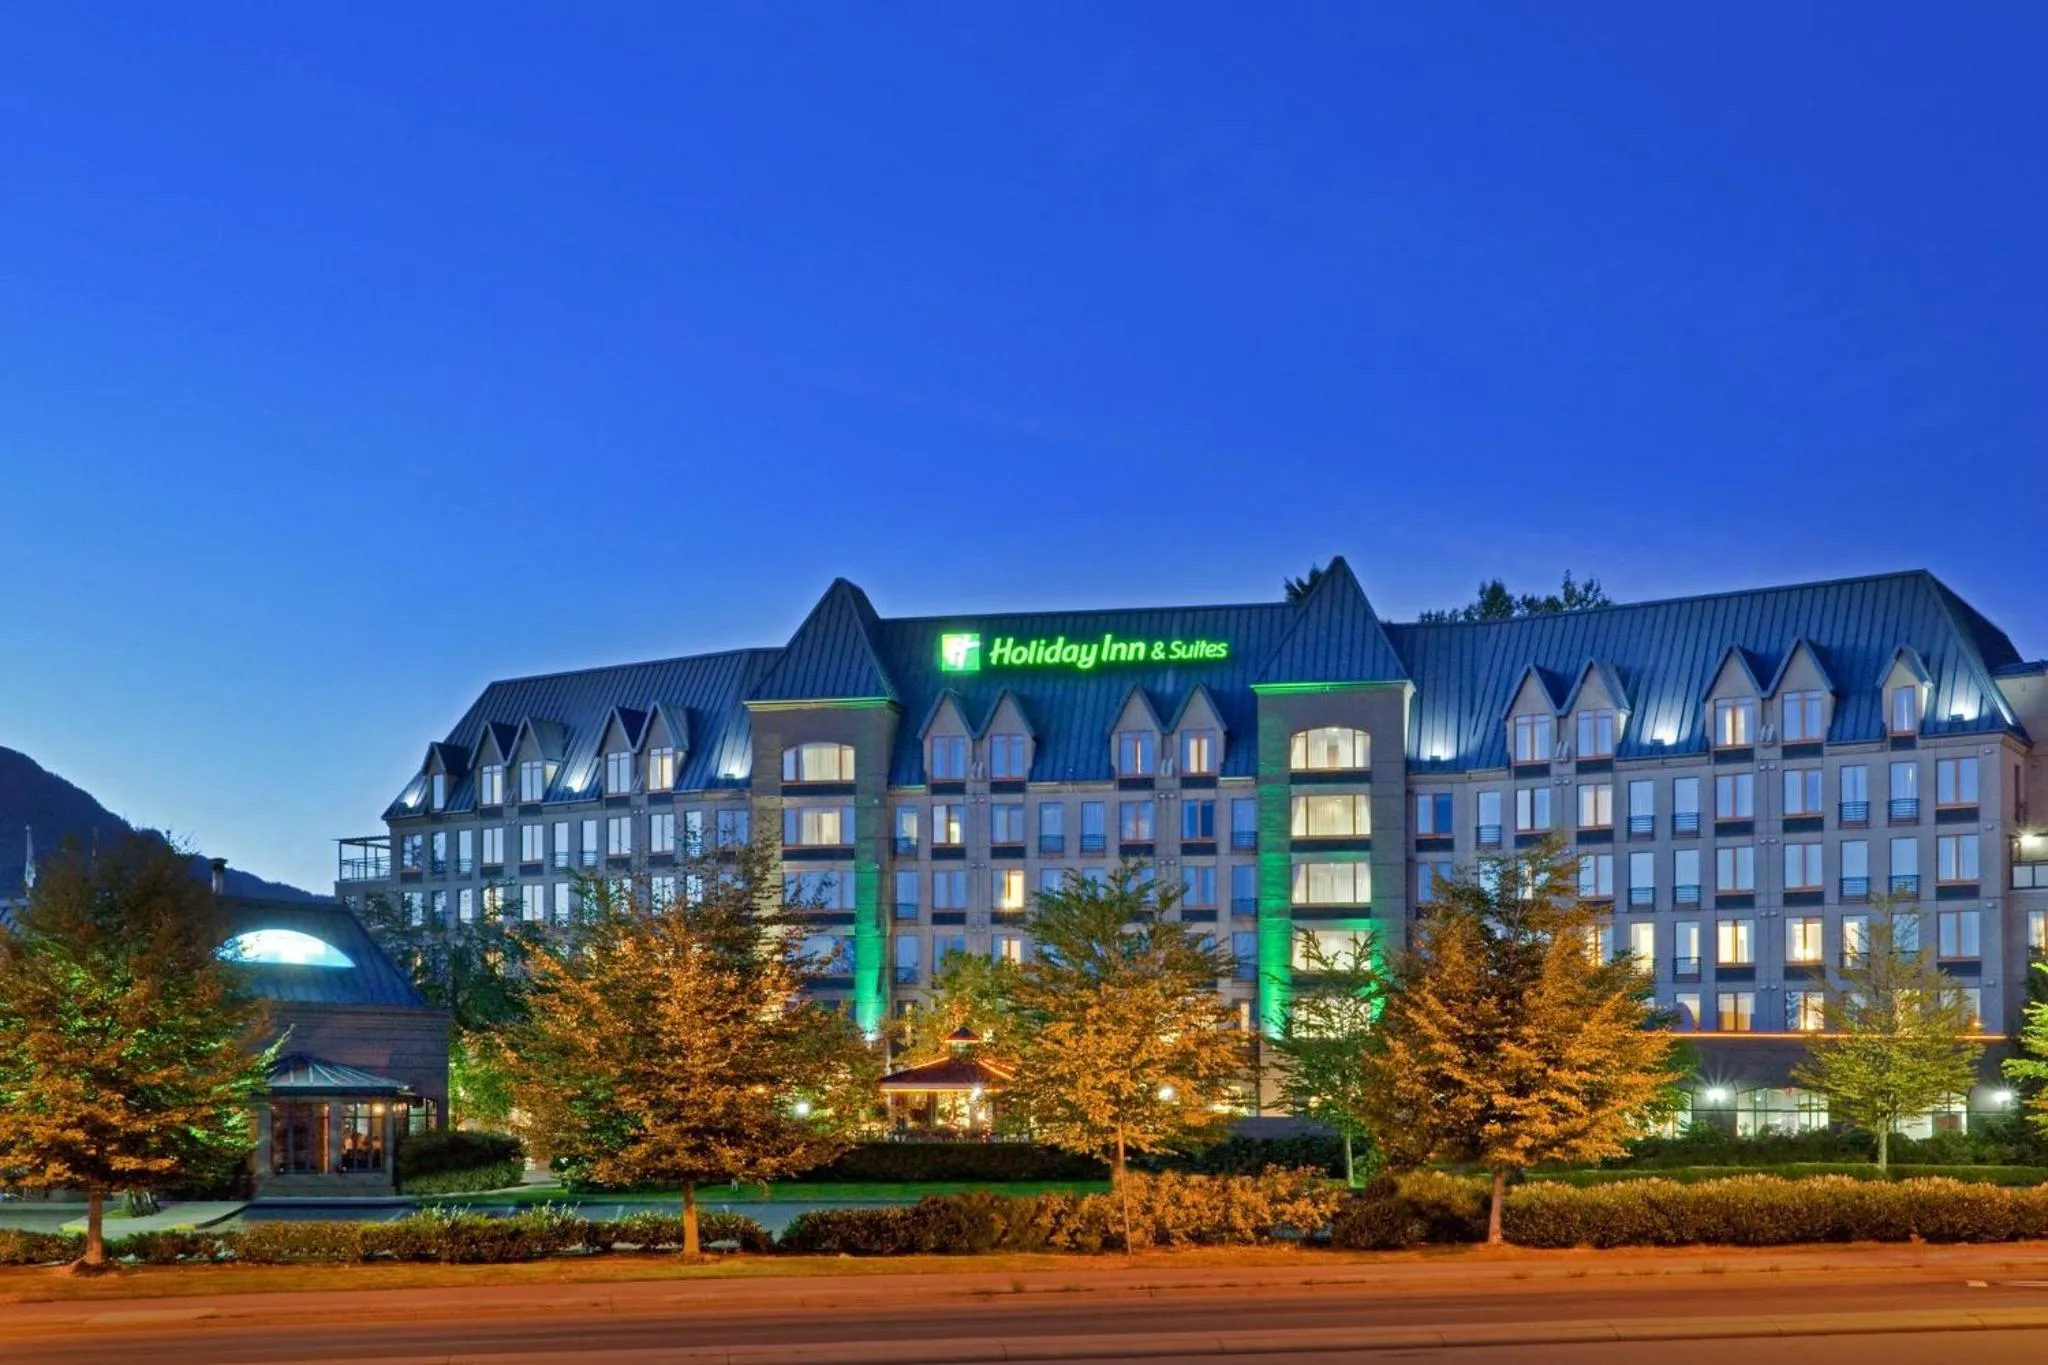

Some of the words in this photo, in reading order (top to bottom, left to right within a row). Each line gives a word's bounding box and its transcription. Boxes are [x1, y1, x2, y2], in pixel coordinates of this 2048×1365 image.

[989, 636, 1098, 669] Holiday
[1101, 634, 1145, 661] Inn
[1150, 641, 1165, 660] &
[1168, 640, 1228, 659] Suites
